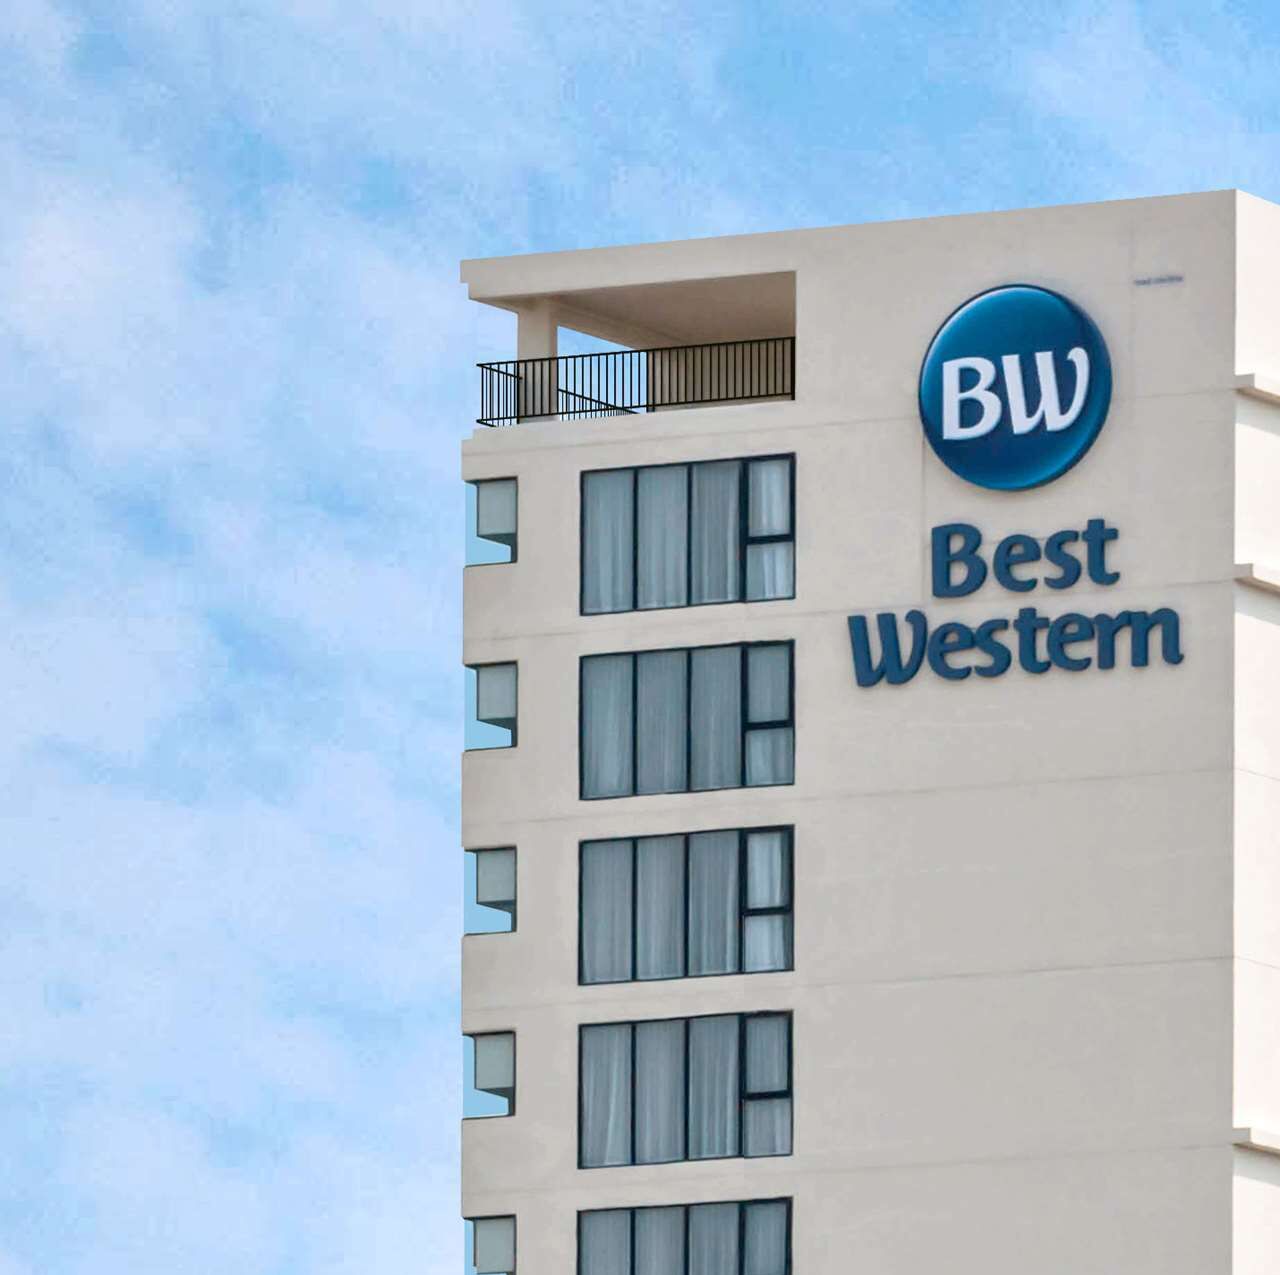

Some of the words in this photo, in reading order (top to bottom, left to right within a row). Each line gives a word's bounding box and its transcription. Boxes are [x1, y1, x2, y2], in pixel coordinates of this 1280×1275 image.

[942, 347, 1090, 440] BW
[930, 518, 1121, 599] Best
[847, 606, 1185, 688] Western
